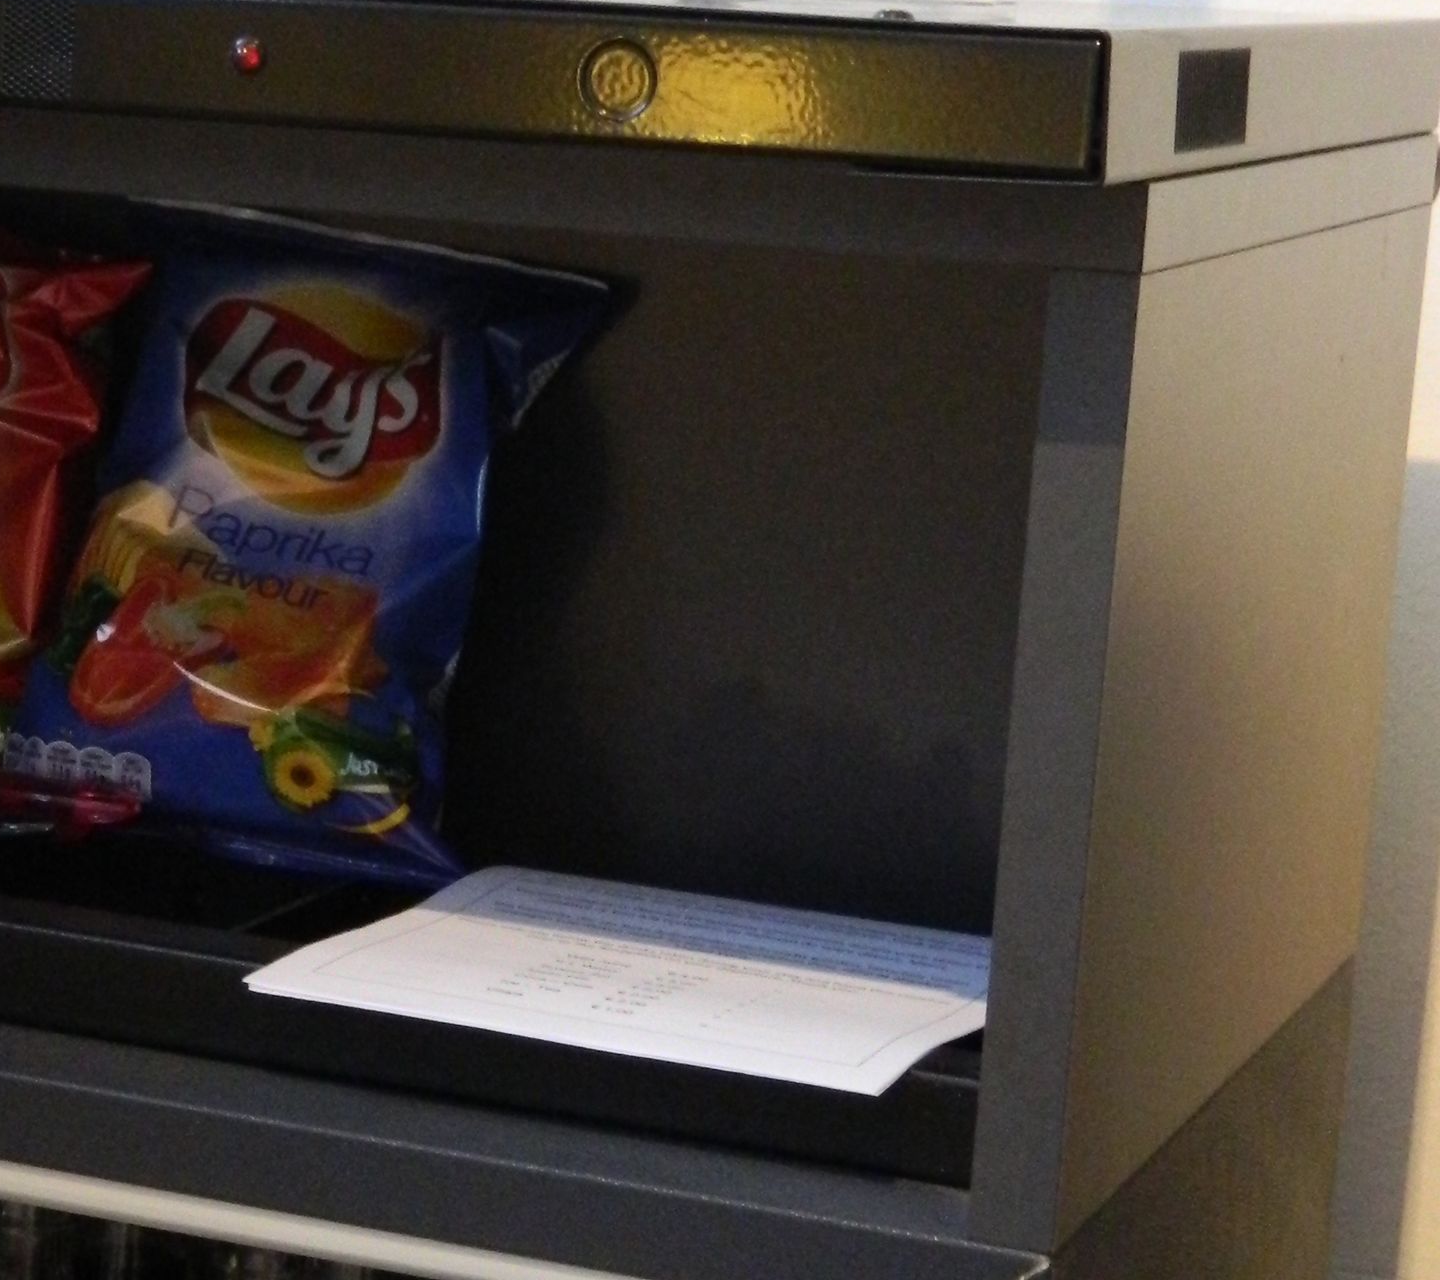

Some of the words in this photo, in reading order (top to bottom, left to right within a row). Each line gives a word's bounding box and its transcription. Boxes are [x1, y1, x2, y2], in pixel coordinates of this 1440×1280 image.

[194, 306, 432, 477] Lay's
[168, 483, 374, 577] Paprika
[176, 548, 328, 610] Flavour
